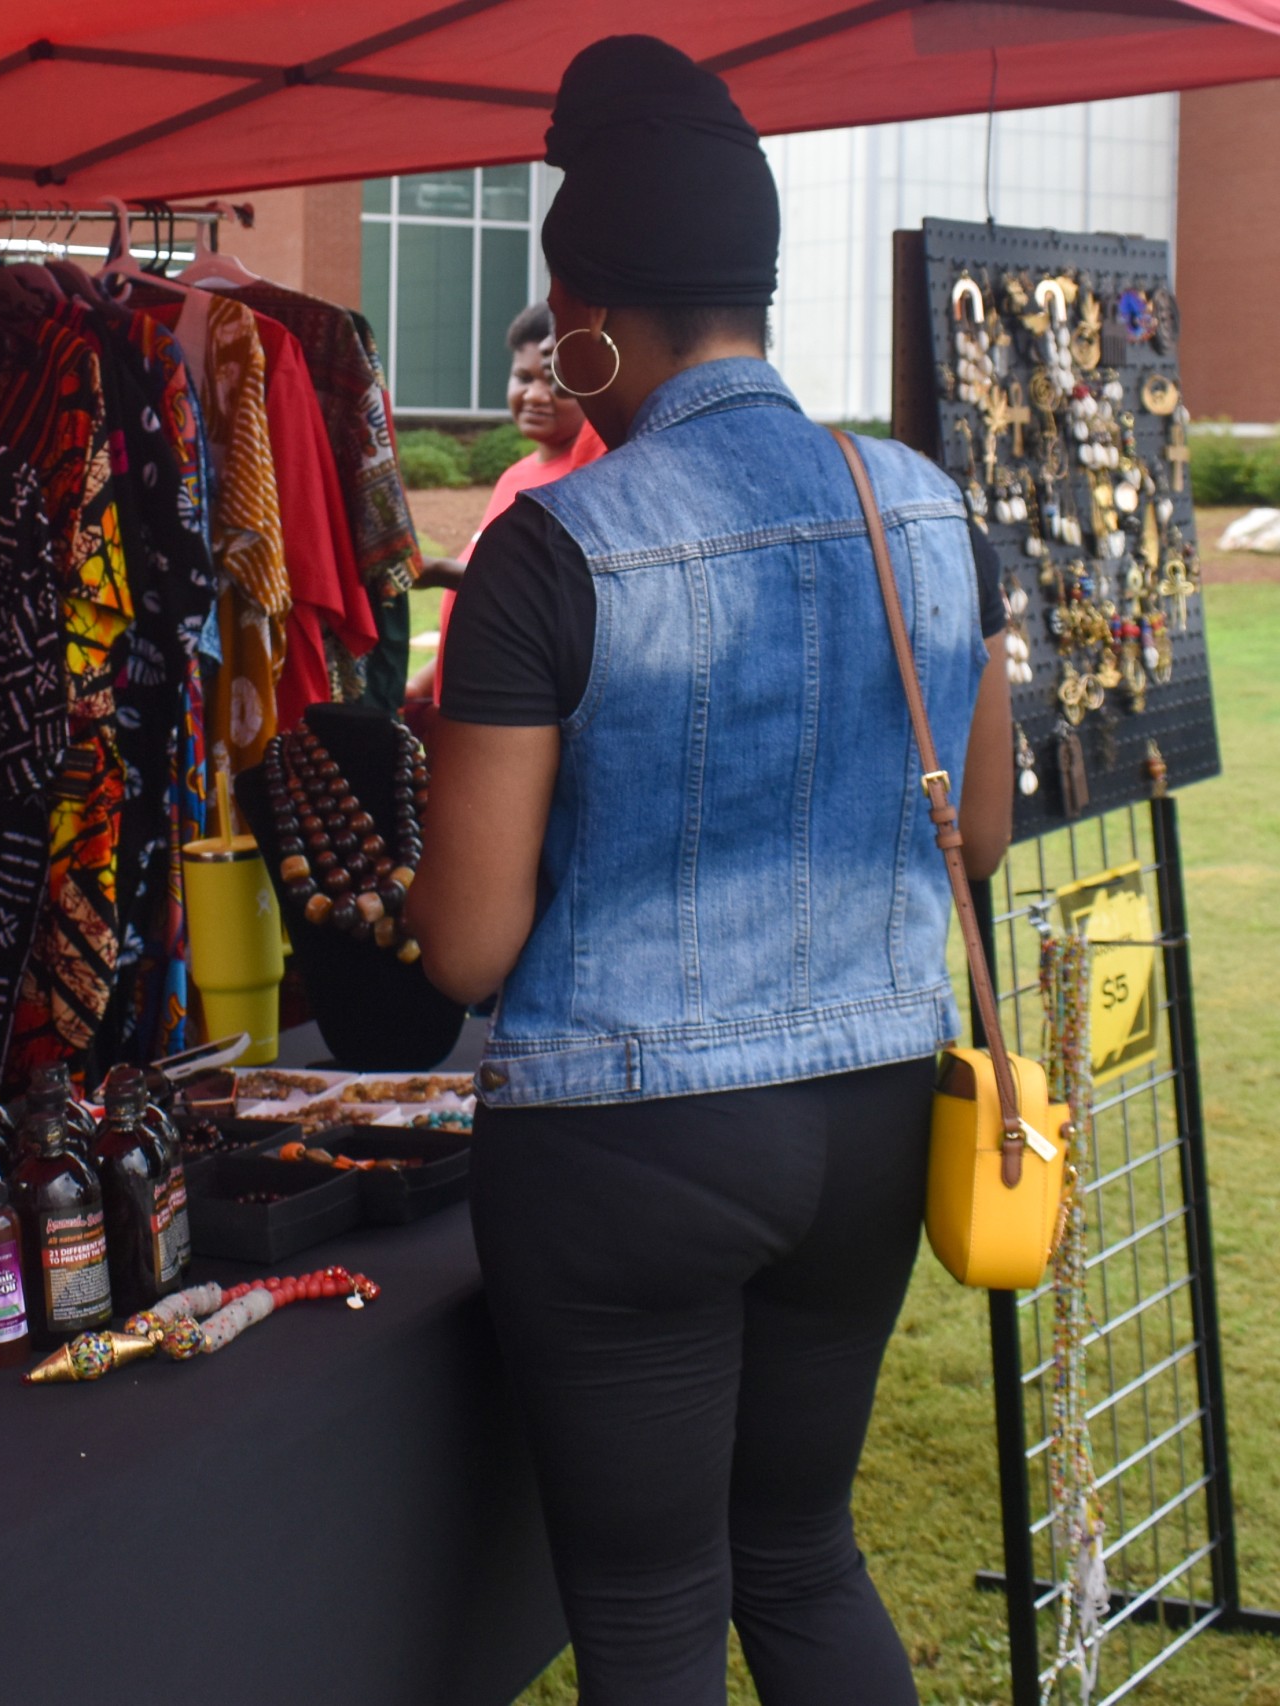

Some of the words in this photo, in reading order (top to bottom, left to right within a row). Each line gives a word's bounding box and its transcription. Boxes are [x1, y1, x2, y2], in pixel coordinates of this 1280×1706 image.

[1102, 974, 1129, 1009] $5
[49, 1249, 59, 1258] 21
[61, 1241, 97, 1256] DIFFERENT
[50, 1256, 60, 1265] TO
[61, 1251, 91, 1264] PREVENT
